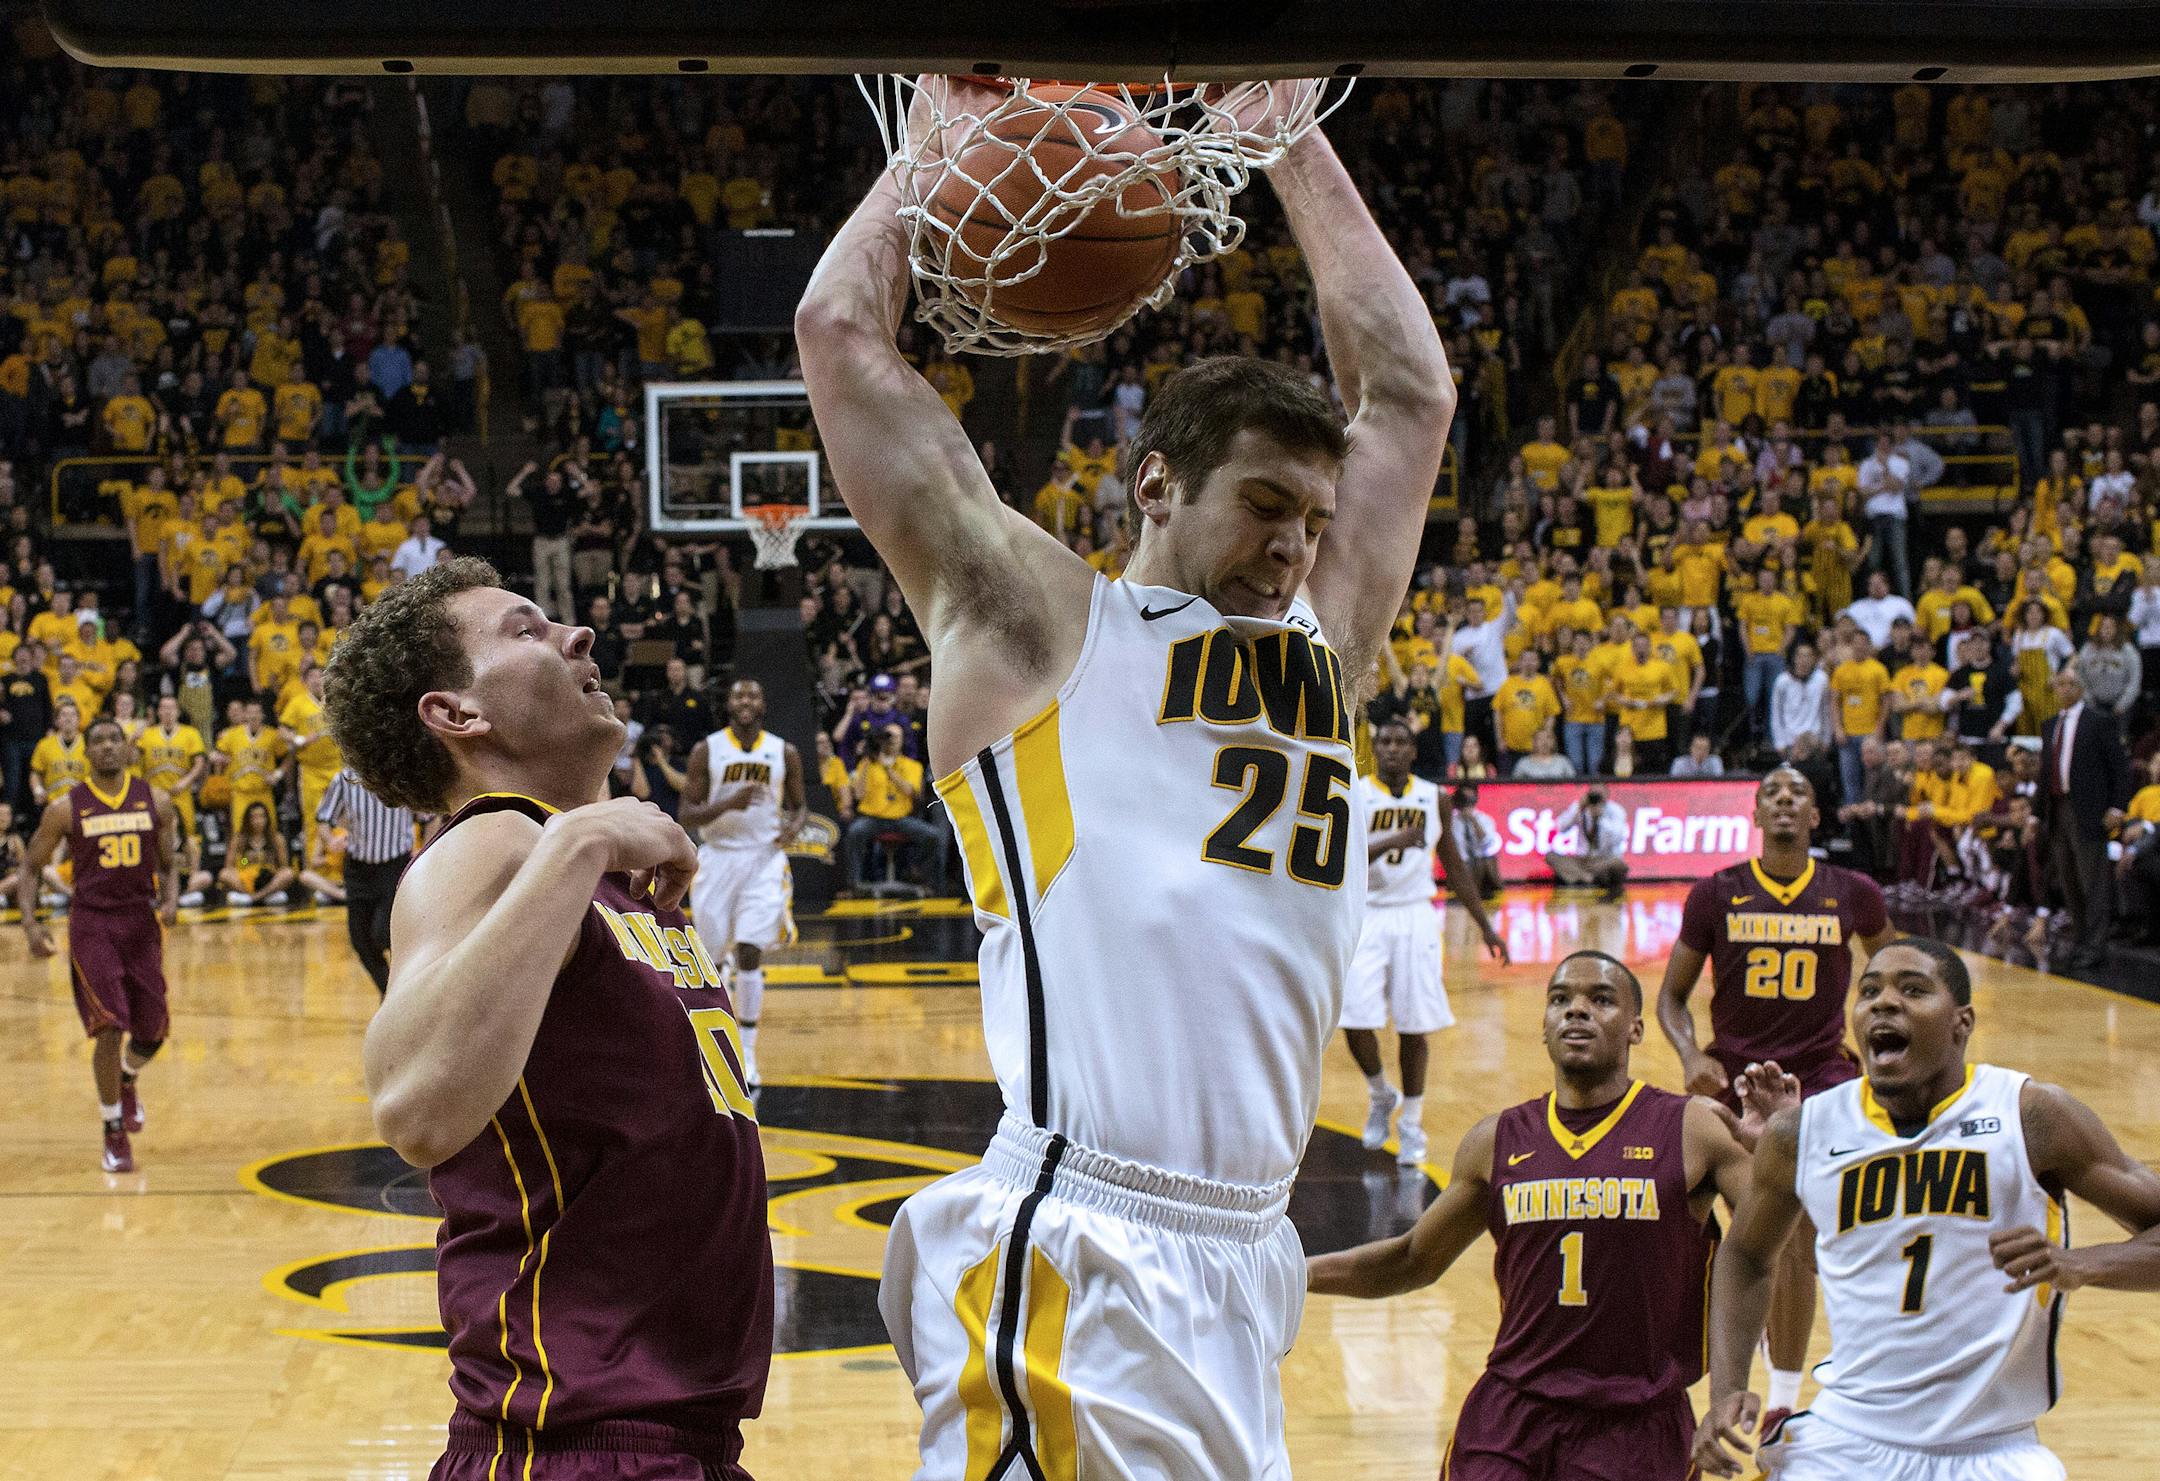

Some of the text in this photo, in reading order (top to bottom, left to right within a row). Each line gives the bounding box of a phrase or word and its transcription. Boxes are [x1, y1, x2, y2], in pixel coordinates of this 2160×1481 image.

[1200, 744, 1352, 890] 25
[1504, 807, 1750, 856] Sta Farm
[98, 833, 141, 869] 30
[1726, 912, 1842, 946] MINNESOTA
[1744, 947, 1818, 1001] 20
[678, 996, 759, 1125] 0
[1502, 1177, 1660, 1226] MINNESOTA
[1837, 1147, 1993, 1236] IOWA
[1558, 1231, 1588, 1306] 1
[1901, 1233, 1935, 1314] 1
